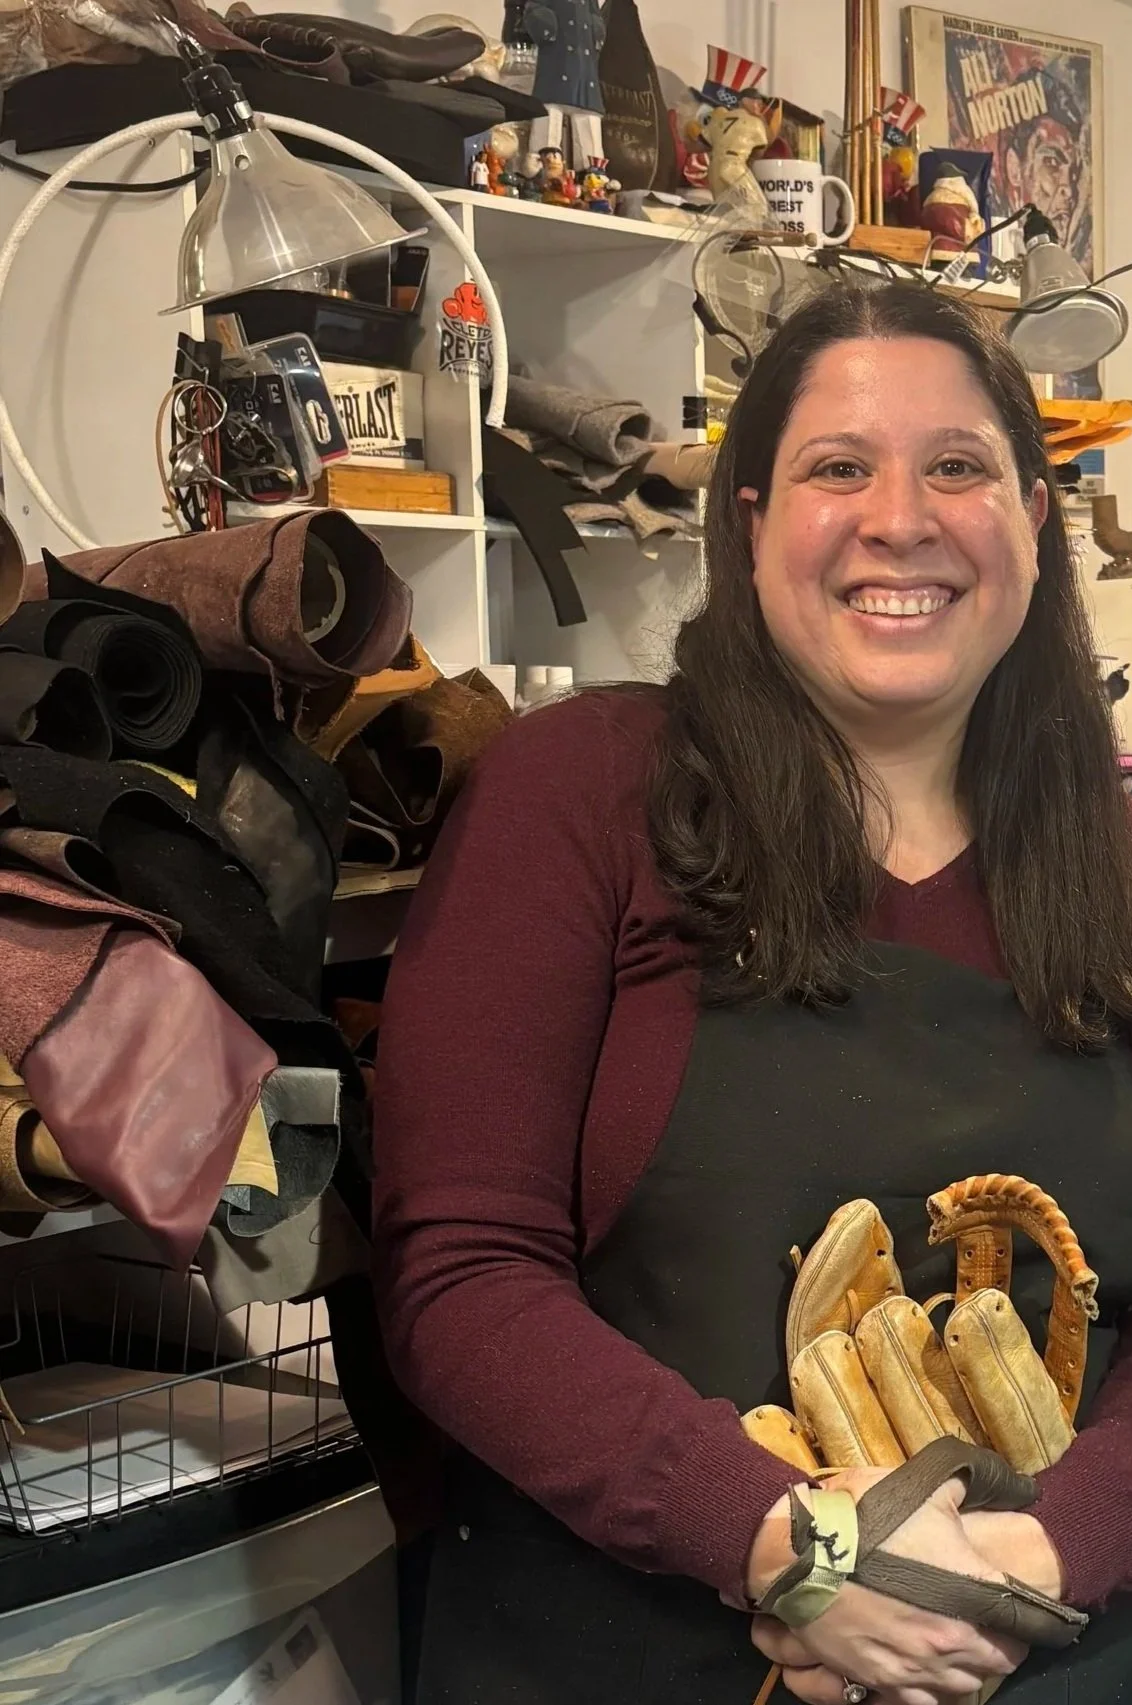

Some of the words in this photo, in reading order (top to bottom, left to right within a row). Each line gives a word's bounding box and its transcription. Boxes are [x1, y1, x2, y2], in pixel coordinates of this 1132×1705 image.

[967, 72, 1047, 140] NORTON
[758, 180, 814, 193] WORLD'S
[439, 329, 494, 370] REYES
